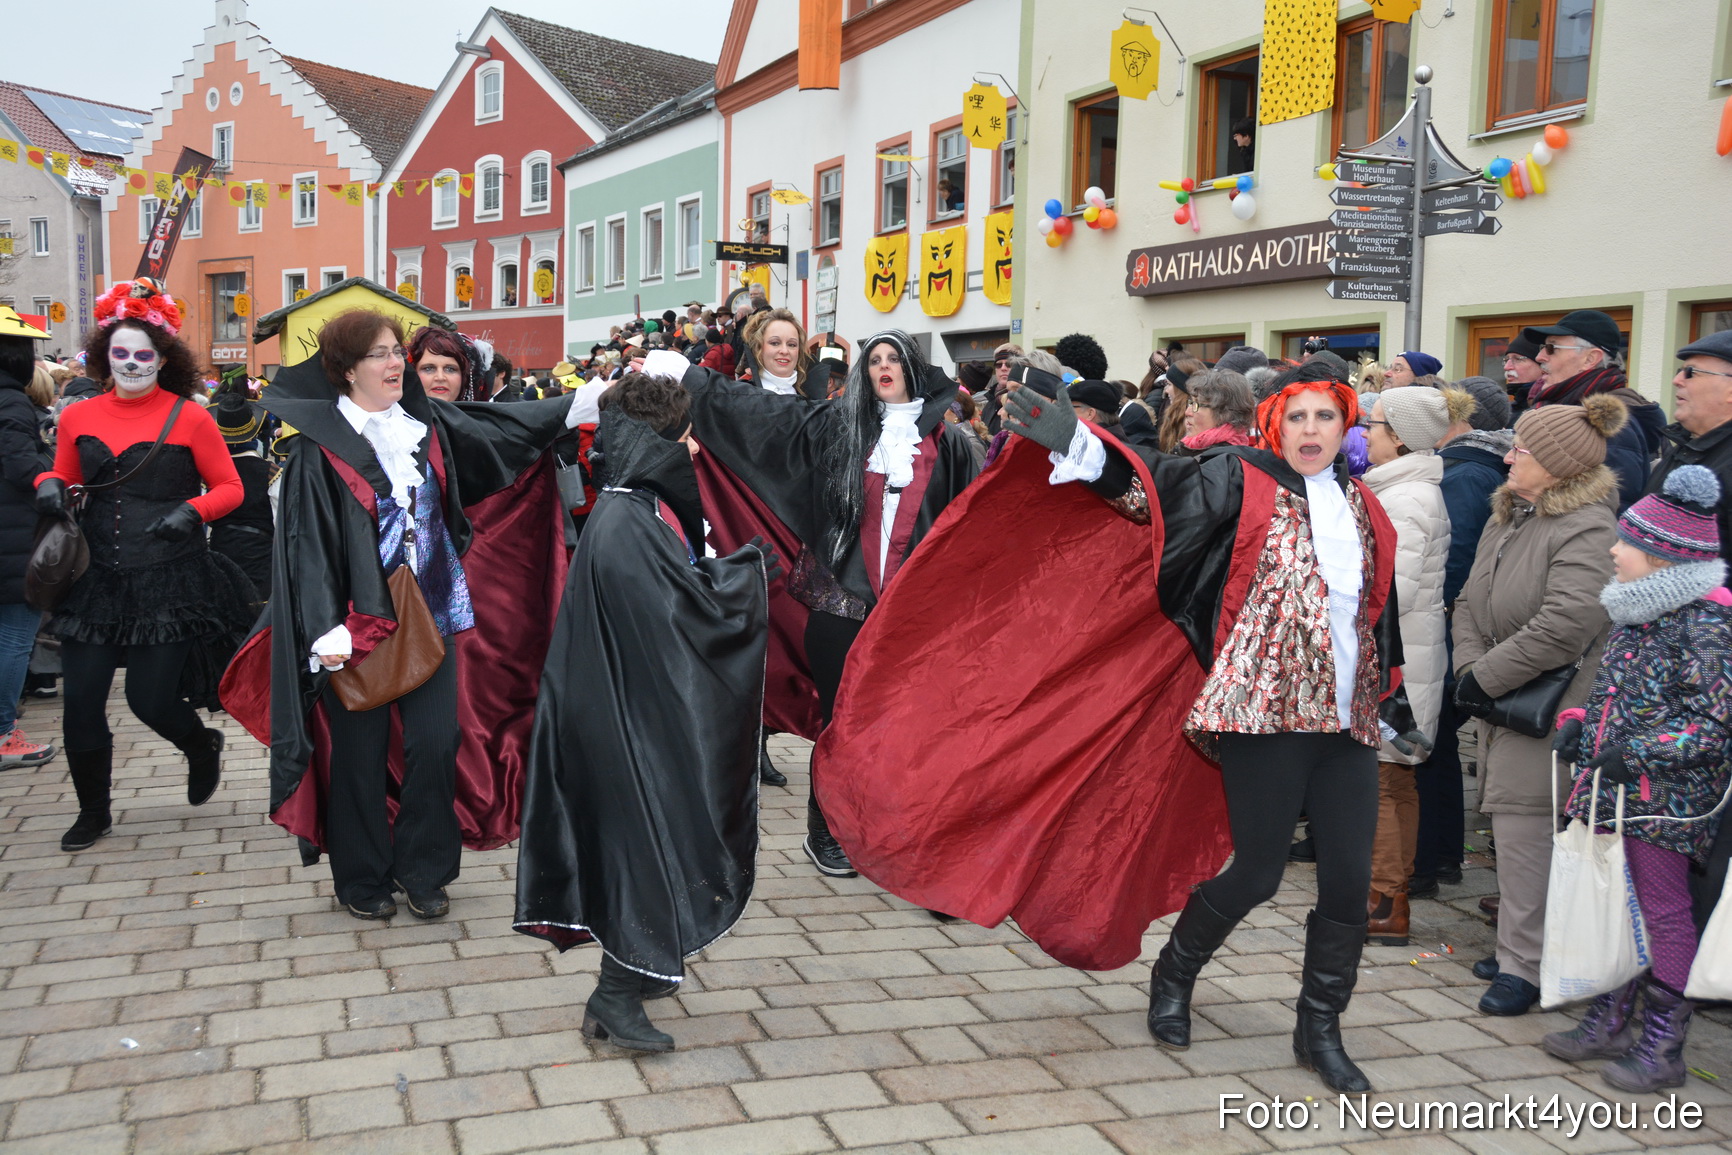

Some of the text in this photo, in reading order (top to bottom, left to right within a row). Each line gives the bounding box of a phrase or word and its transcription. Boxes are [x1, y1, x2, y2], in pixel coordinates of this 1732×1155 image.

[1352, 164, 1397, 175] Museum im
[1353, 173, 1395, 184] Hollerhaus
[1340, 191, 1405, 205] Wassertretanlage
[1435, 193, 1469, 207] Keltenhaus
[1340, 211, 1403, 222] Meditationshaus
[1337, 220, 1405, 231] Franziskanerkloster
[1436, 216, 1473, 230] Barfußpark
[1348, 235, 1399, 246] Mariengrotte
[723, 244, 781, 256] RÖHLICH
[1356, 244, 1396, 255] Kreuzberg
[77, 233, 87, 282] UHREN
[1151, 228, 1365, 284] RATHAUS APOTHE
[1340, 262, 1401, 275] Franziskuspark
[1347, 282, 1393, 292] Kulturhaus
[1341, 290, 1398, 301] Stadtbücherei
[211, 347, 248, 359] GÖTZ
